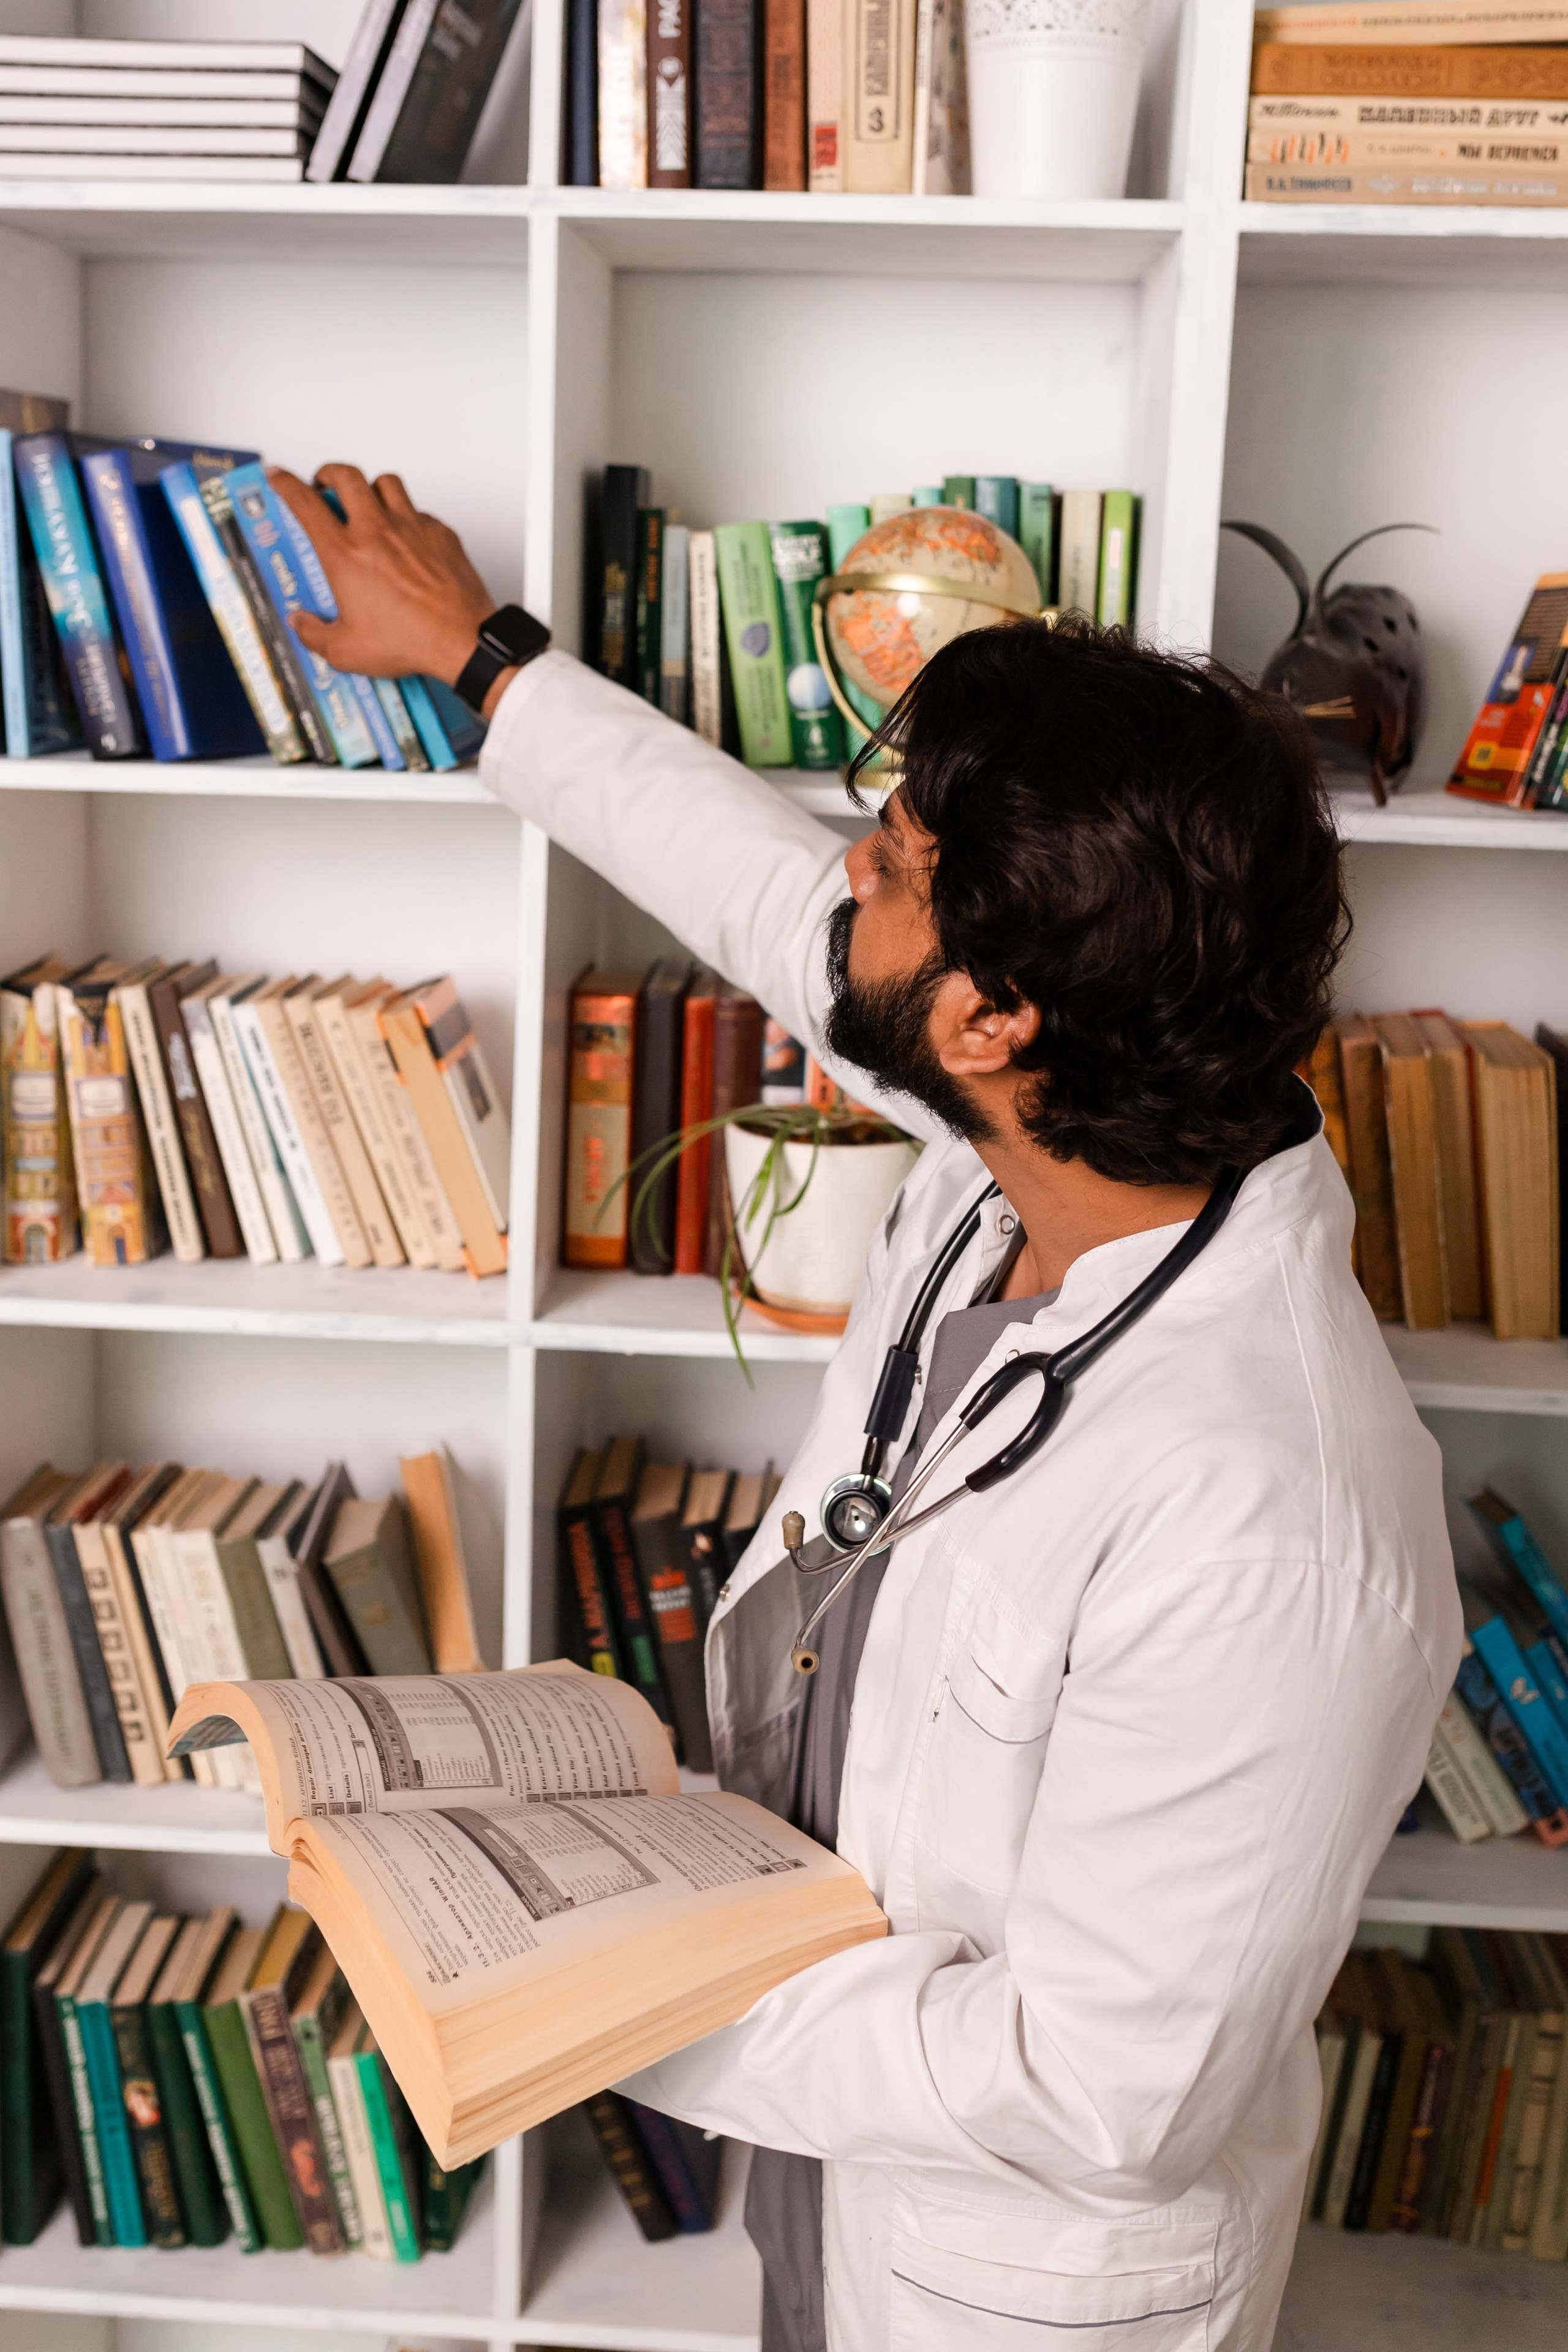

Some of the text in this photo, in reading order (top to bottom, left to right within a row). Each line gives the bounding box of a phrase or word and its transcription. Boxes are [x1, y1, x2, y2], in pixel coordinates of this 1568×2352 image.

[1458, 142, 1558, 162] МЫ ВЕРНЕМСЯ
[428, 1877, 449, 1901] WinRAR
[447, 1904, 473, 1940] Архиватор
